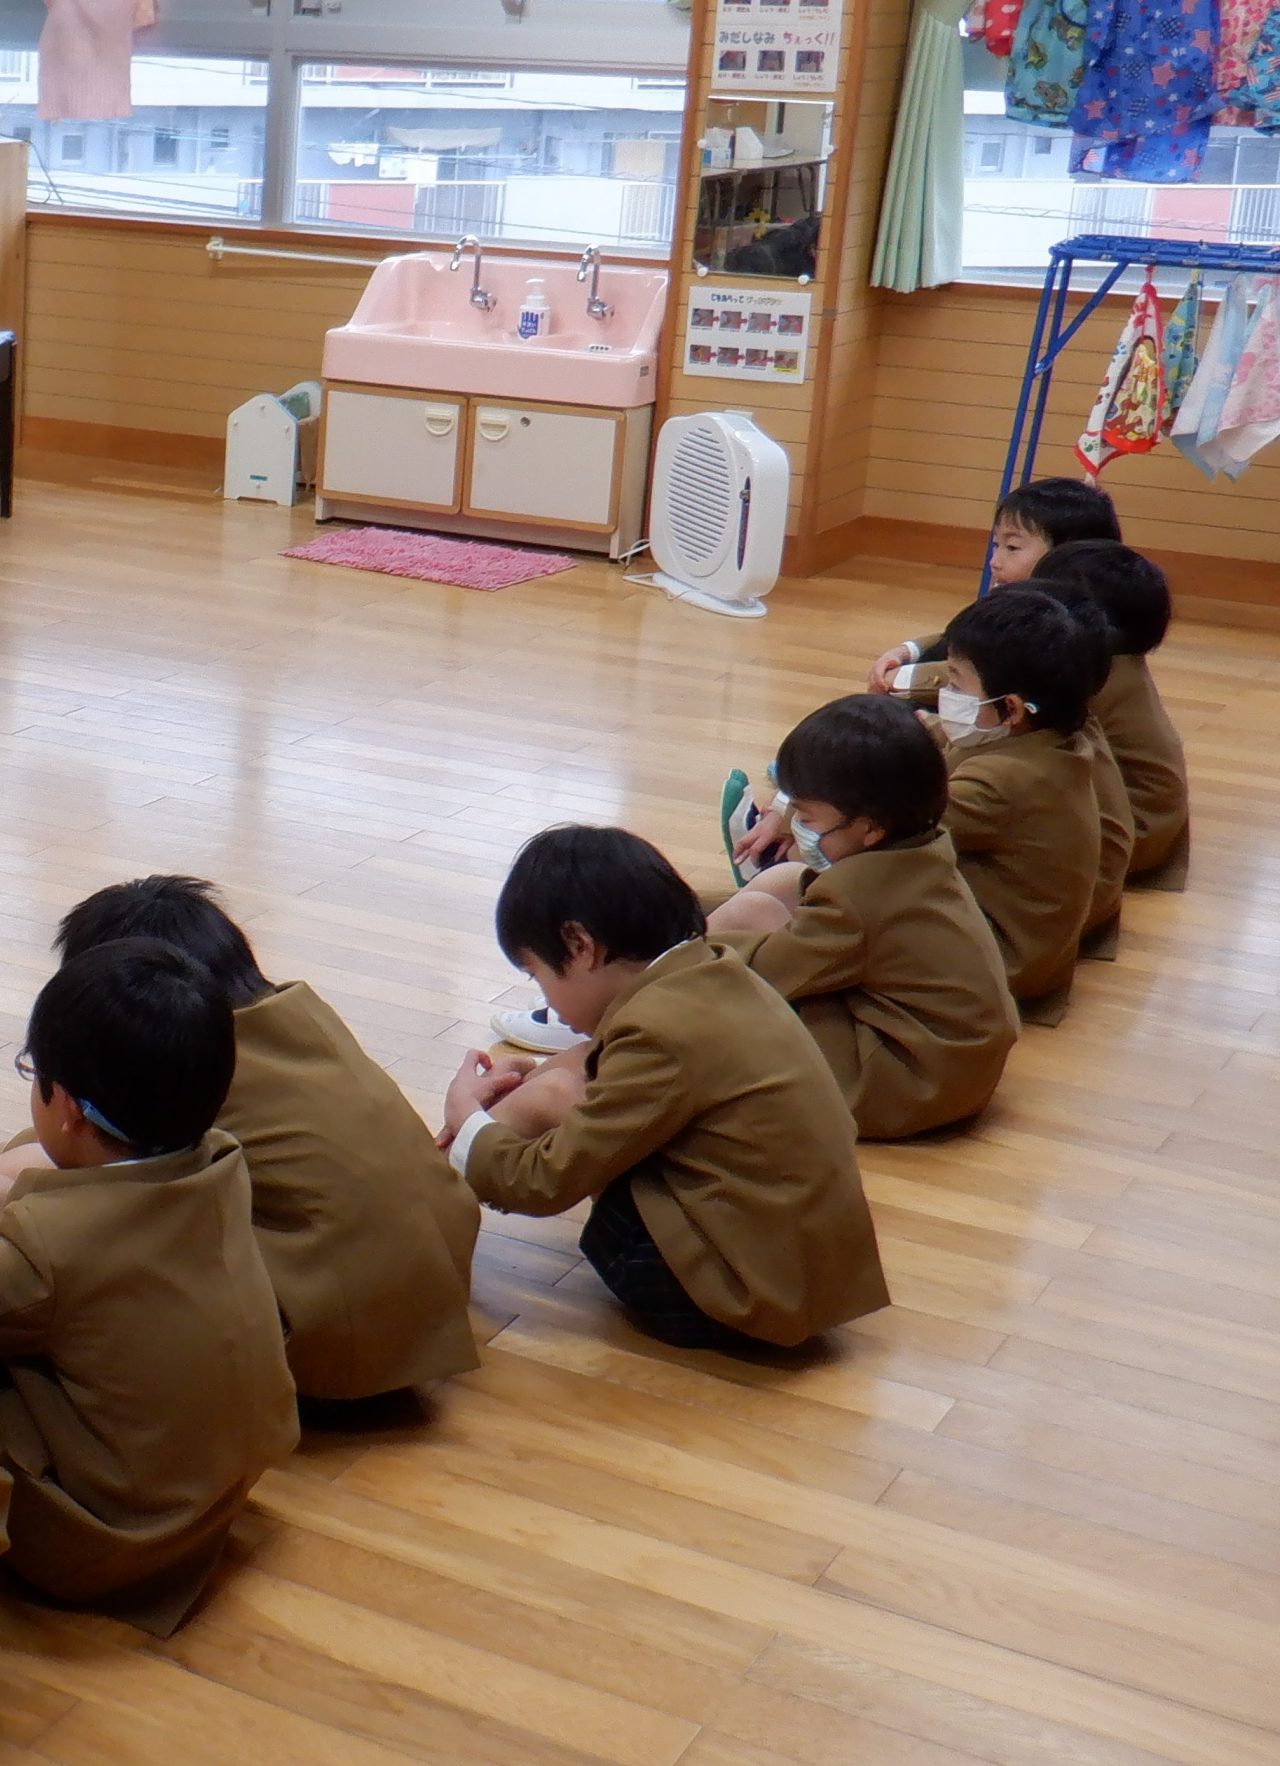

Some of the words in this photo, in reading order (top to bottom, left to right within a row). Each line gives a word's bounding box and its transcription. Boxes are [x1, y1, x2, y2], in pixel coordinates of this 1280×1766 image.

[718, 31, 775, 45] みだしなみ
